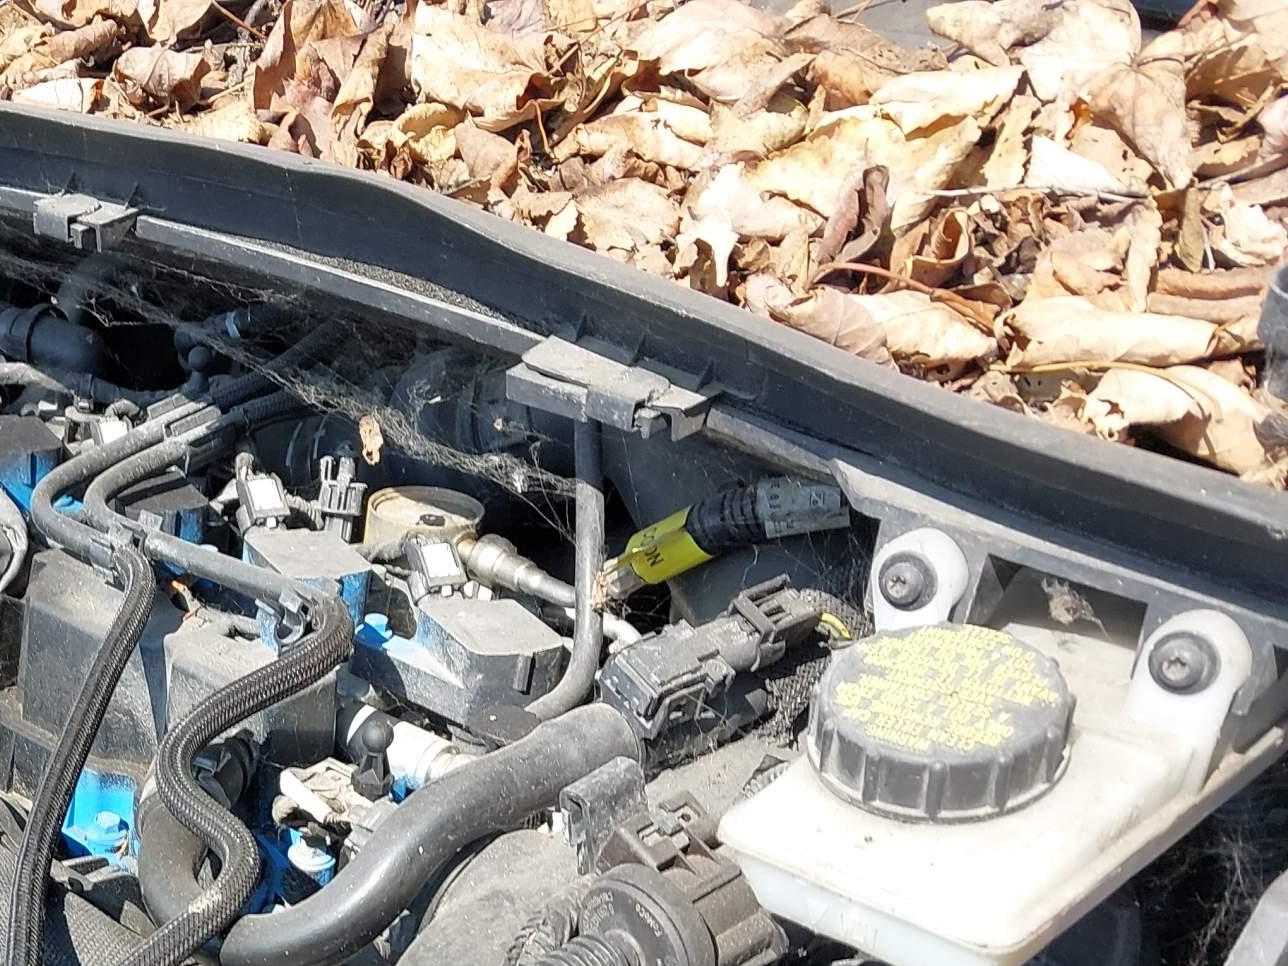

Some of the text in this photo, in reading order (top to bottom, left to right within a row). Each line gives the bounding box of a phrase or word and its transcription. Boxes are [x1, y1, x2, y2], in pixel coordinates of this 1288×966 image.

[861, 722, 931, 751] WARNING:
[872, 712, 923, 736] FILLER
[943, 719, 1003, 747] BEFORE
[925, 727, 976, 752] CLEAN
[635, 903, 663, 937] FoMoCo
